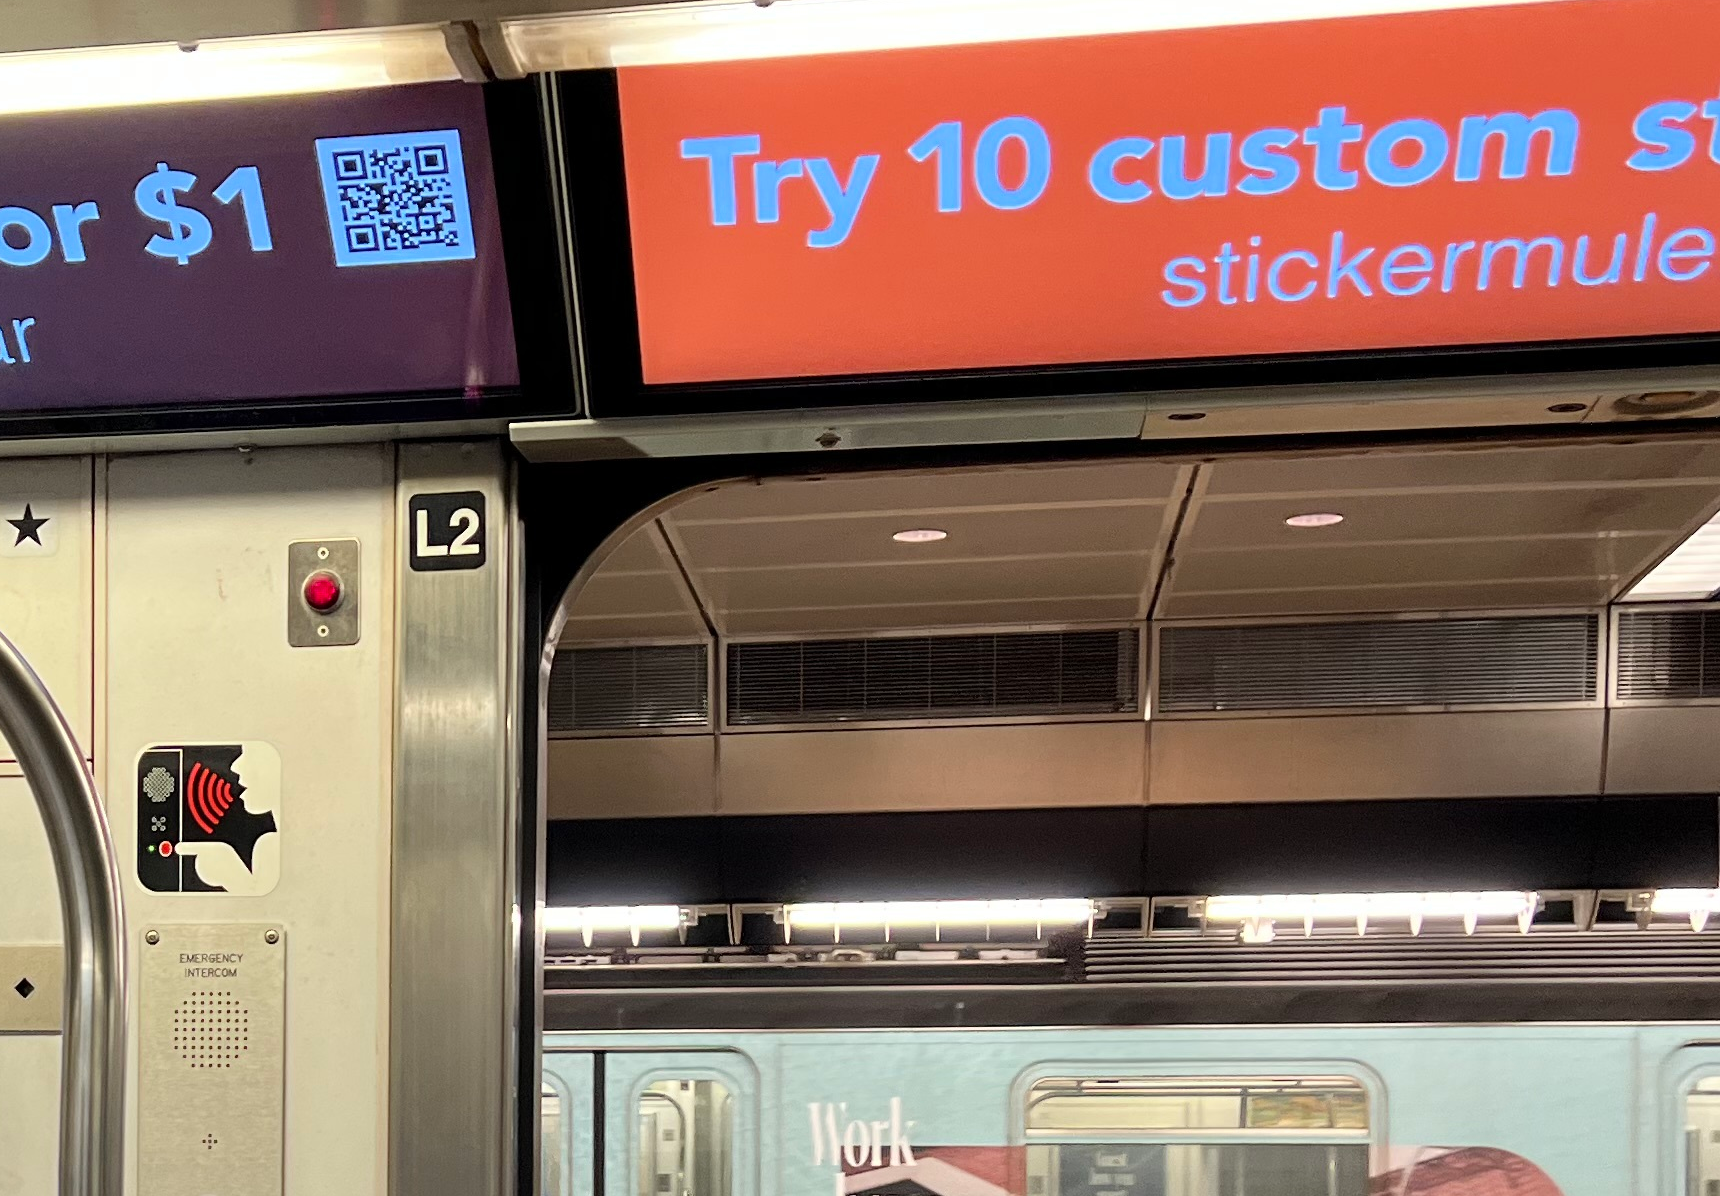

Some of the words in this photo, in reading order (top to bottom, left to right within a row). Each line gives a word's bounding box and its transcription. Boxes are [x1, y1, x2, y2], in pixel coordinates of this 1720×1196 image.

[680, 134, 879, 248] Try
[908, 115, 1050, 213] 10
[1088, 106, 1578, 203] custom
[135, 160, 273, 266] $1
[1161, 212, 1716, 307] stickermule
[416, 506, 481, 557] L2
[179, 953, 243, 964] EMERGENCY
[184, 968, 238, 978] INTERCOM
[808, 1097, 918, 1167] Work
